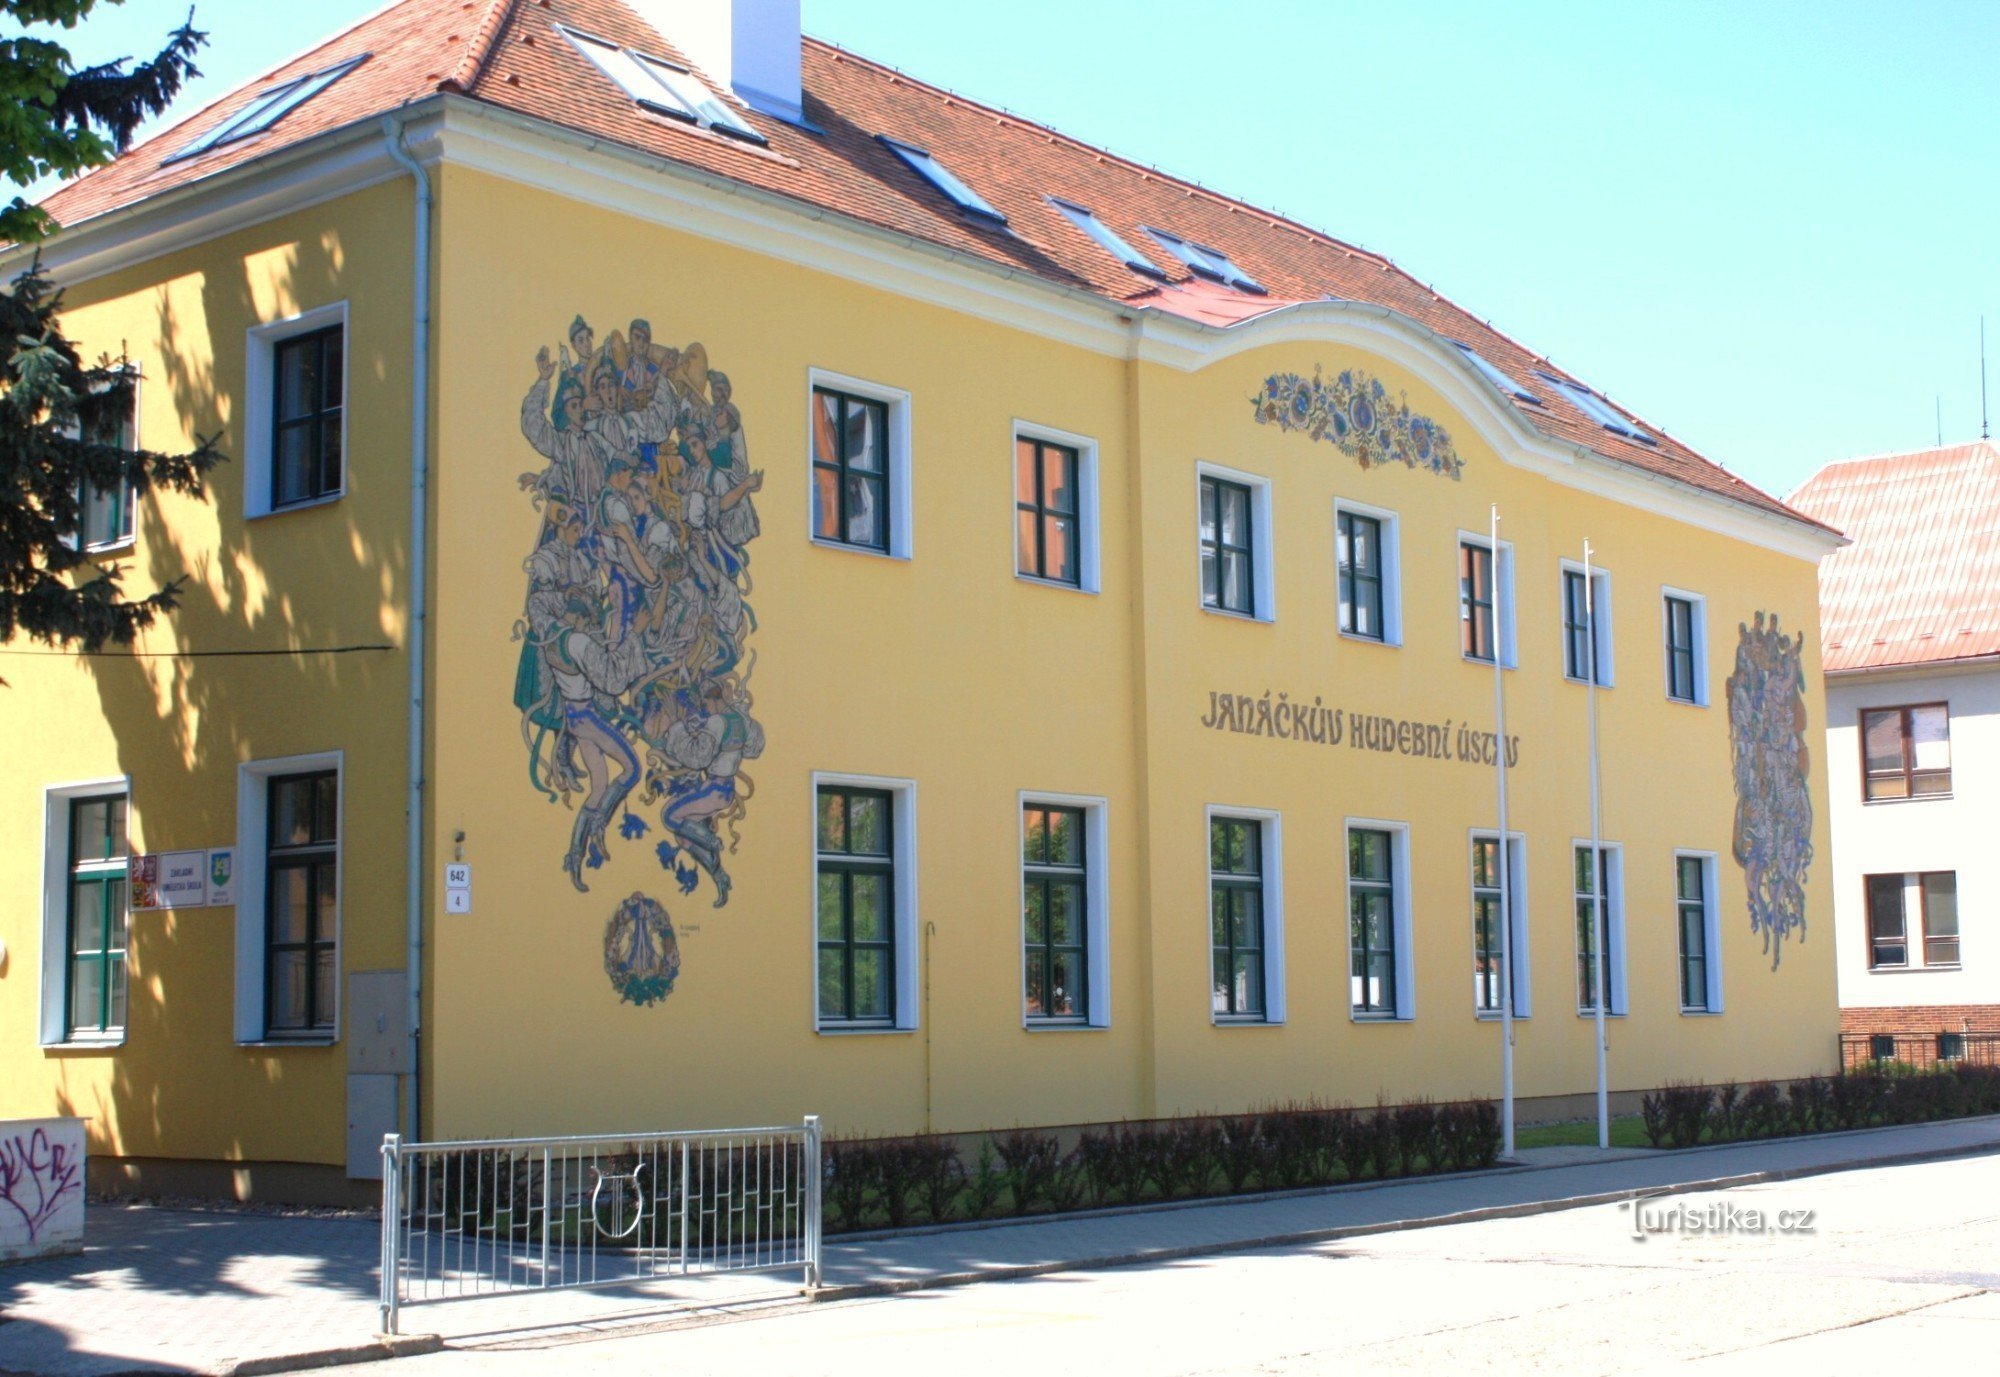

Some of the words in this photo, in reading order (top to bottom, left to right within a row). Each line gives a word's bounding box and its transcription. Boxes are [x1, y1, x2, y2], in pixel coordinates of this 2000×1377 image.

[1200, 689, 1344, 746] JANÁČKŮV
[1348, 712, 1453, 760] HUDEBNÍ
[450, 870, 465, 881] 642
[455, 895, 461, 907] 4
